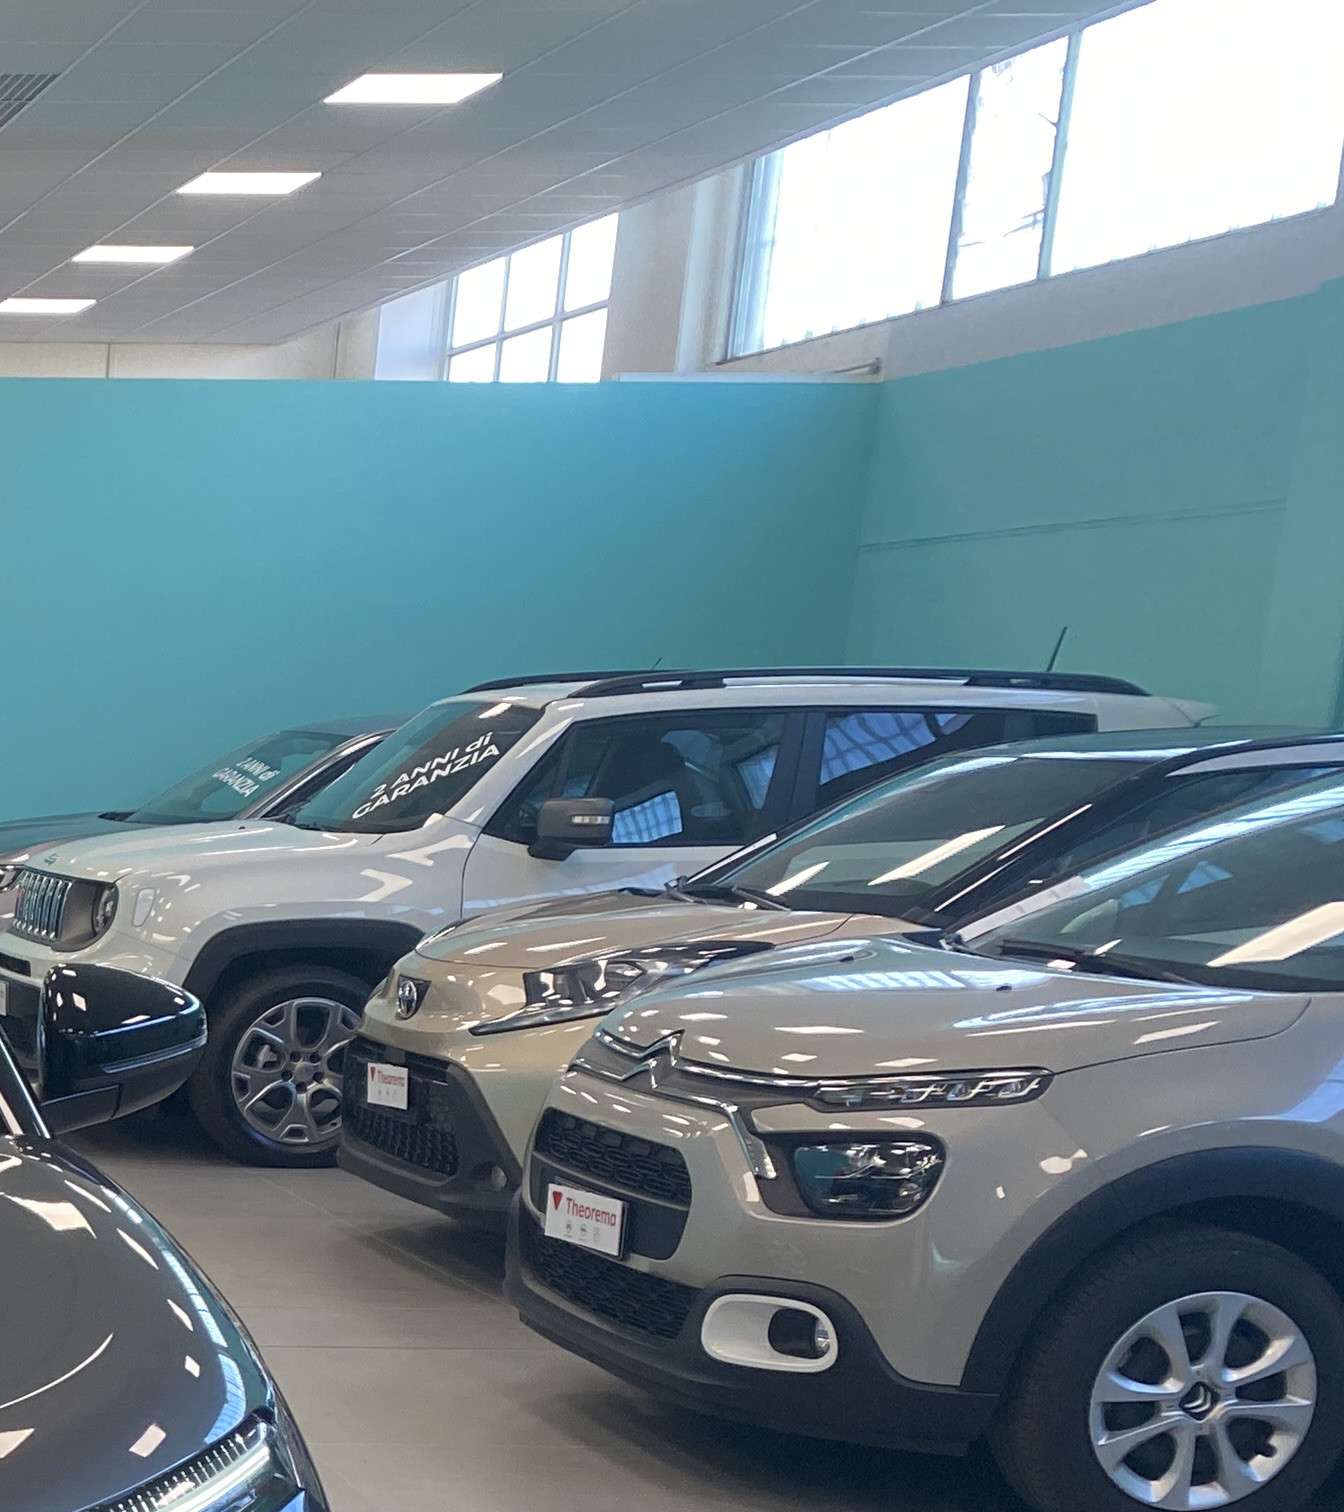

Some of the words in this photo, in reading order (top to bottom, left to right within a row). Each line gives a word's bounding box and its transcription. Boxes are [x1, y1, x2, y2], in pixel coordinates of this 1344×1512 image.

[352, 744, 500, 819] GARANZIA
[370, 783, 387, 799] 2
[390, 748, 460, 790] ANNI
[465, 731, 493, 753] di
[565, 1196, 617, 1228] Theorema
